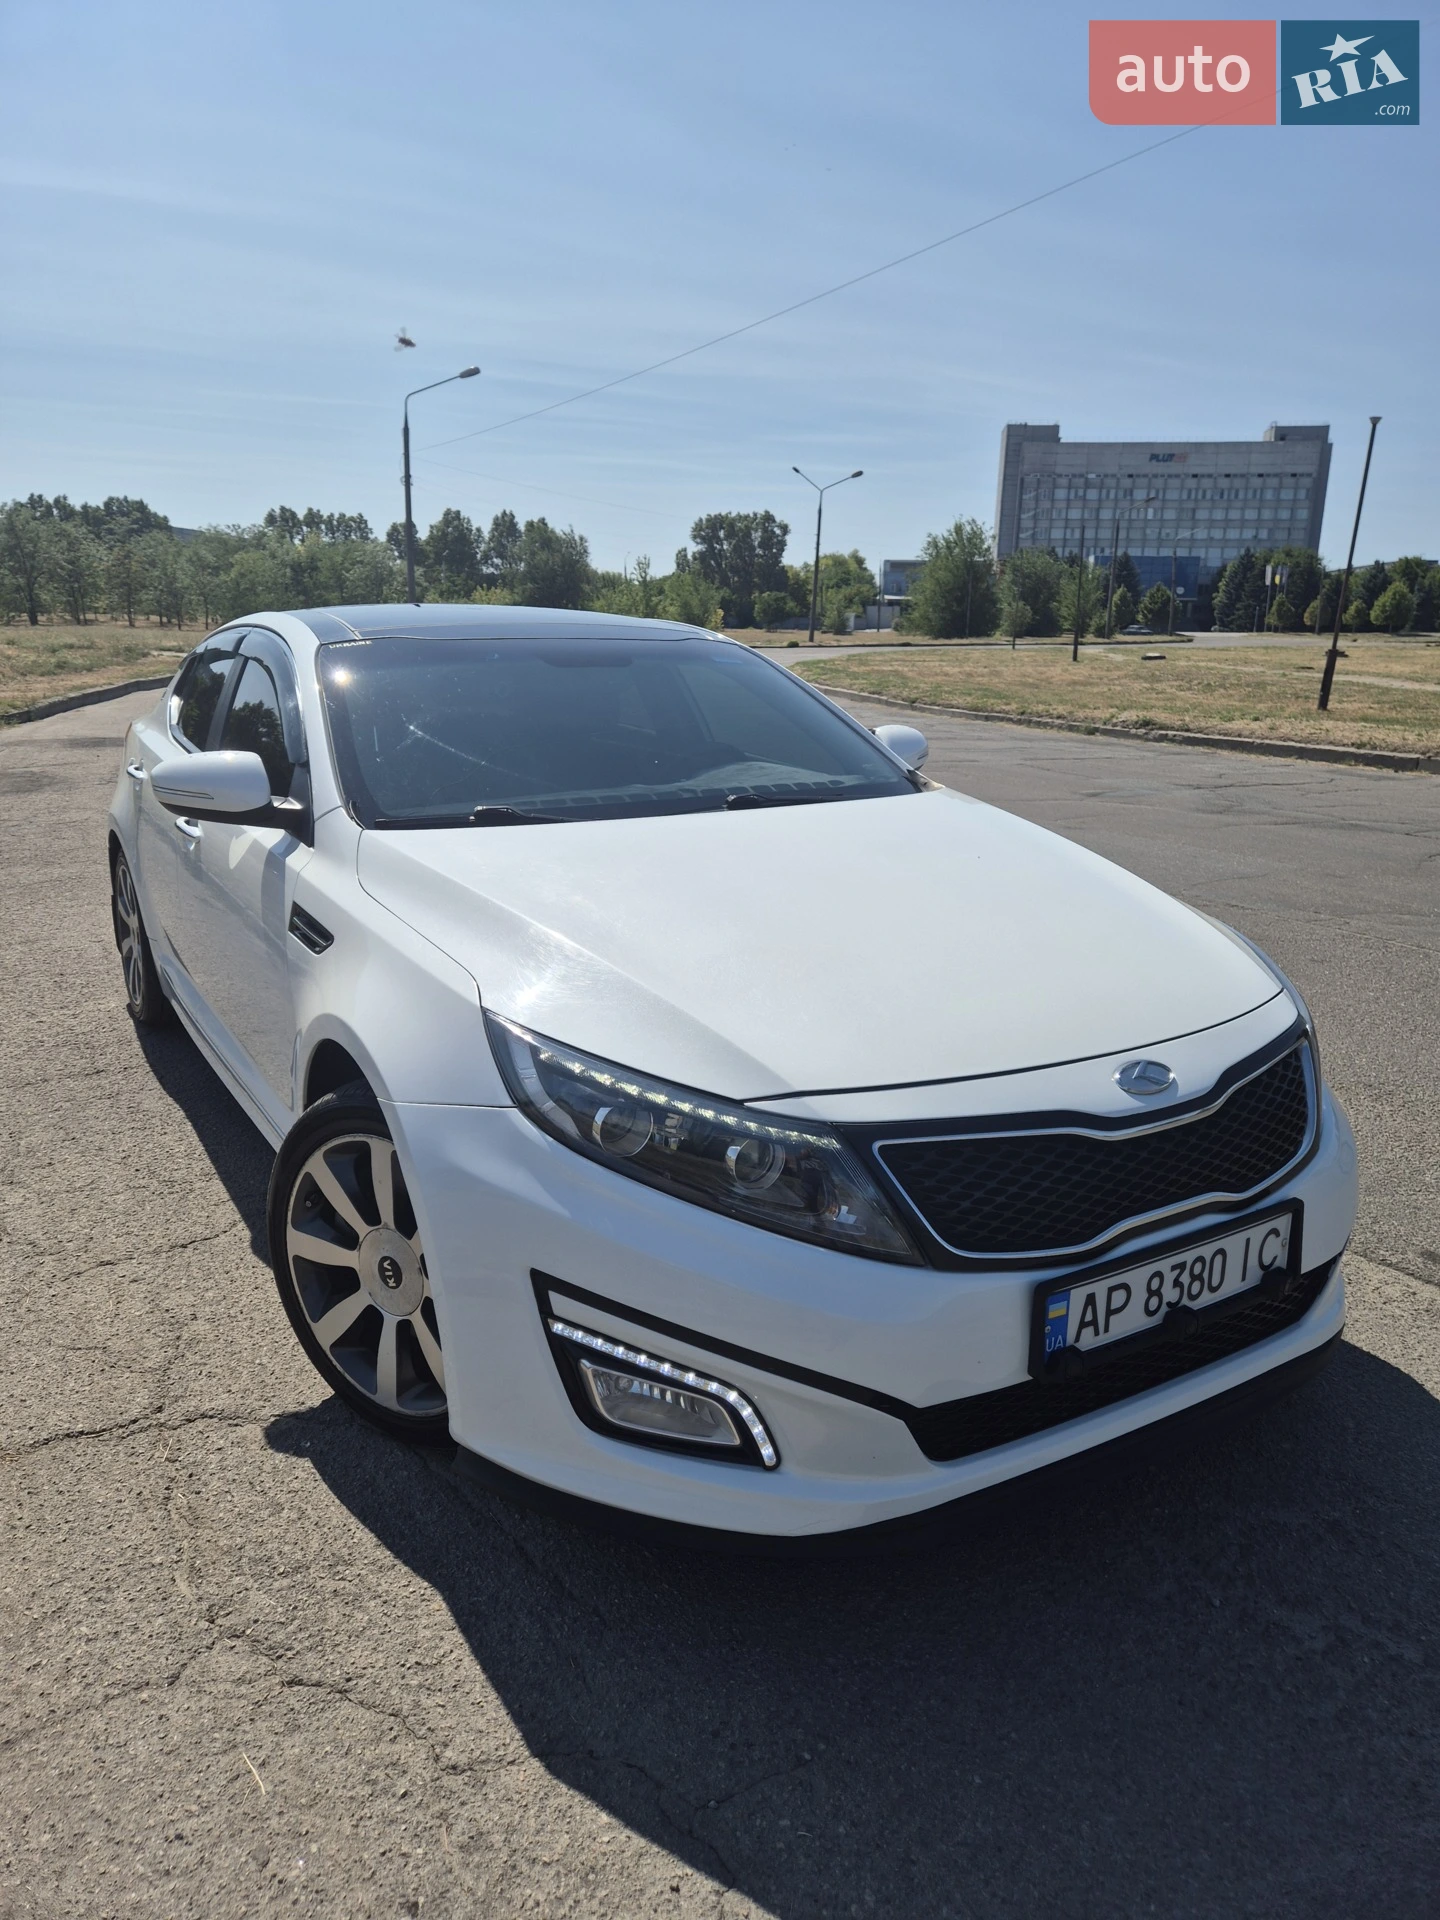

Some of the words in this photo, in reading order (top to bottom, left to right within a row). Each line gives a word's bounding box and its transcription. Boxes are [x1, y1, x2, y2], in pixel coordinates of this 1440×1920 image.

[383, 1259, 397, 1287] KIA
[1074, 1281, 1132, 1344] AP
[1143, 1247, 1228, 1318] 8380
[1240, 1227, 1281, 1282] IC
[1046, 1335, 1064, 1352] UA
